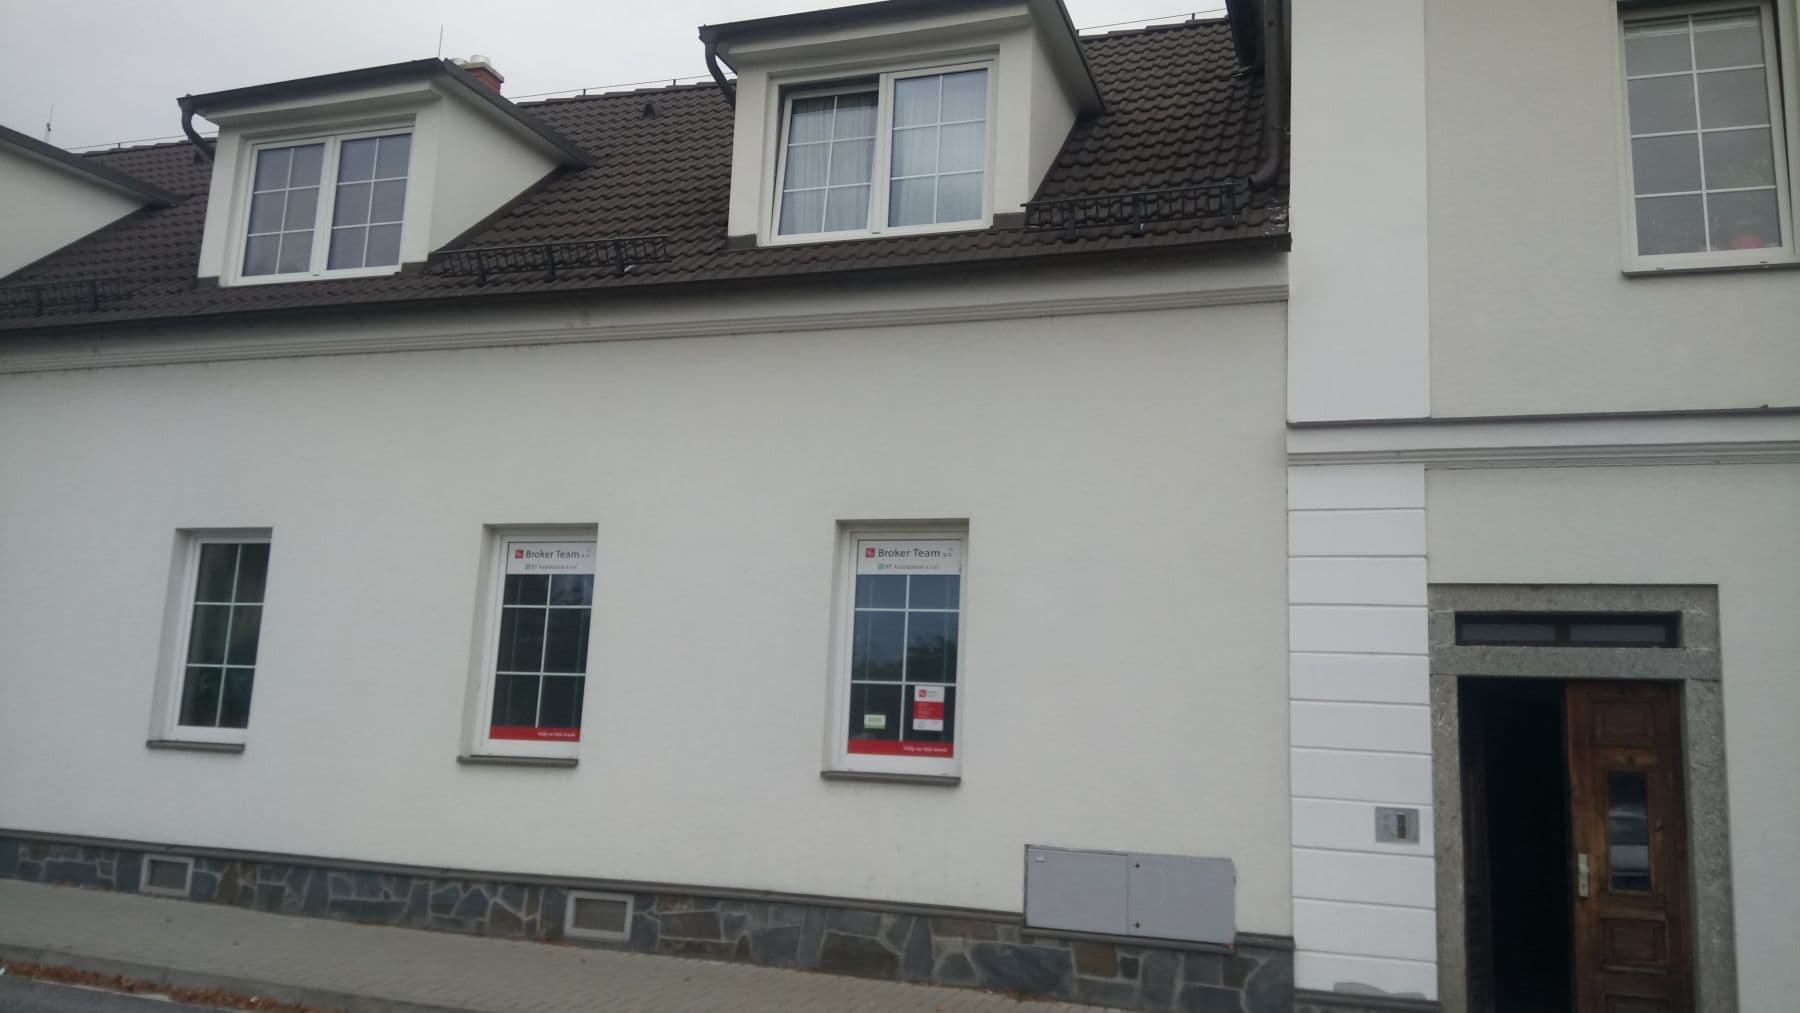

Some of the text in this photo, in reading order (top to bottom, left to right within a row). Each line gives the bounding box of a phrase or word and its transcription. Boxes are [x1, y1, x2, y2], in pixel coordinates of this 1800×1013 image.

[525, 549, 554, 559] Broker
[556, 549, 580, 559] Team
[878, 547, 911, 558] Broker
[913, 547, 941, 558] Team
